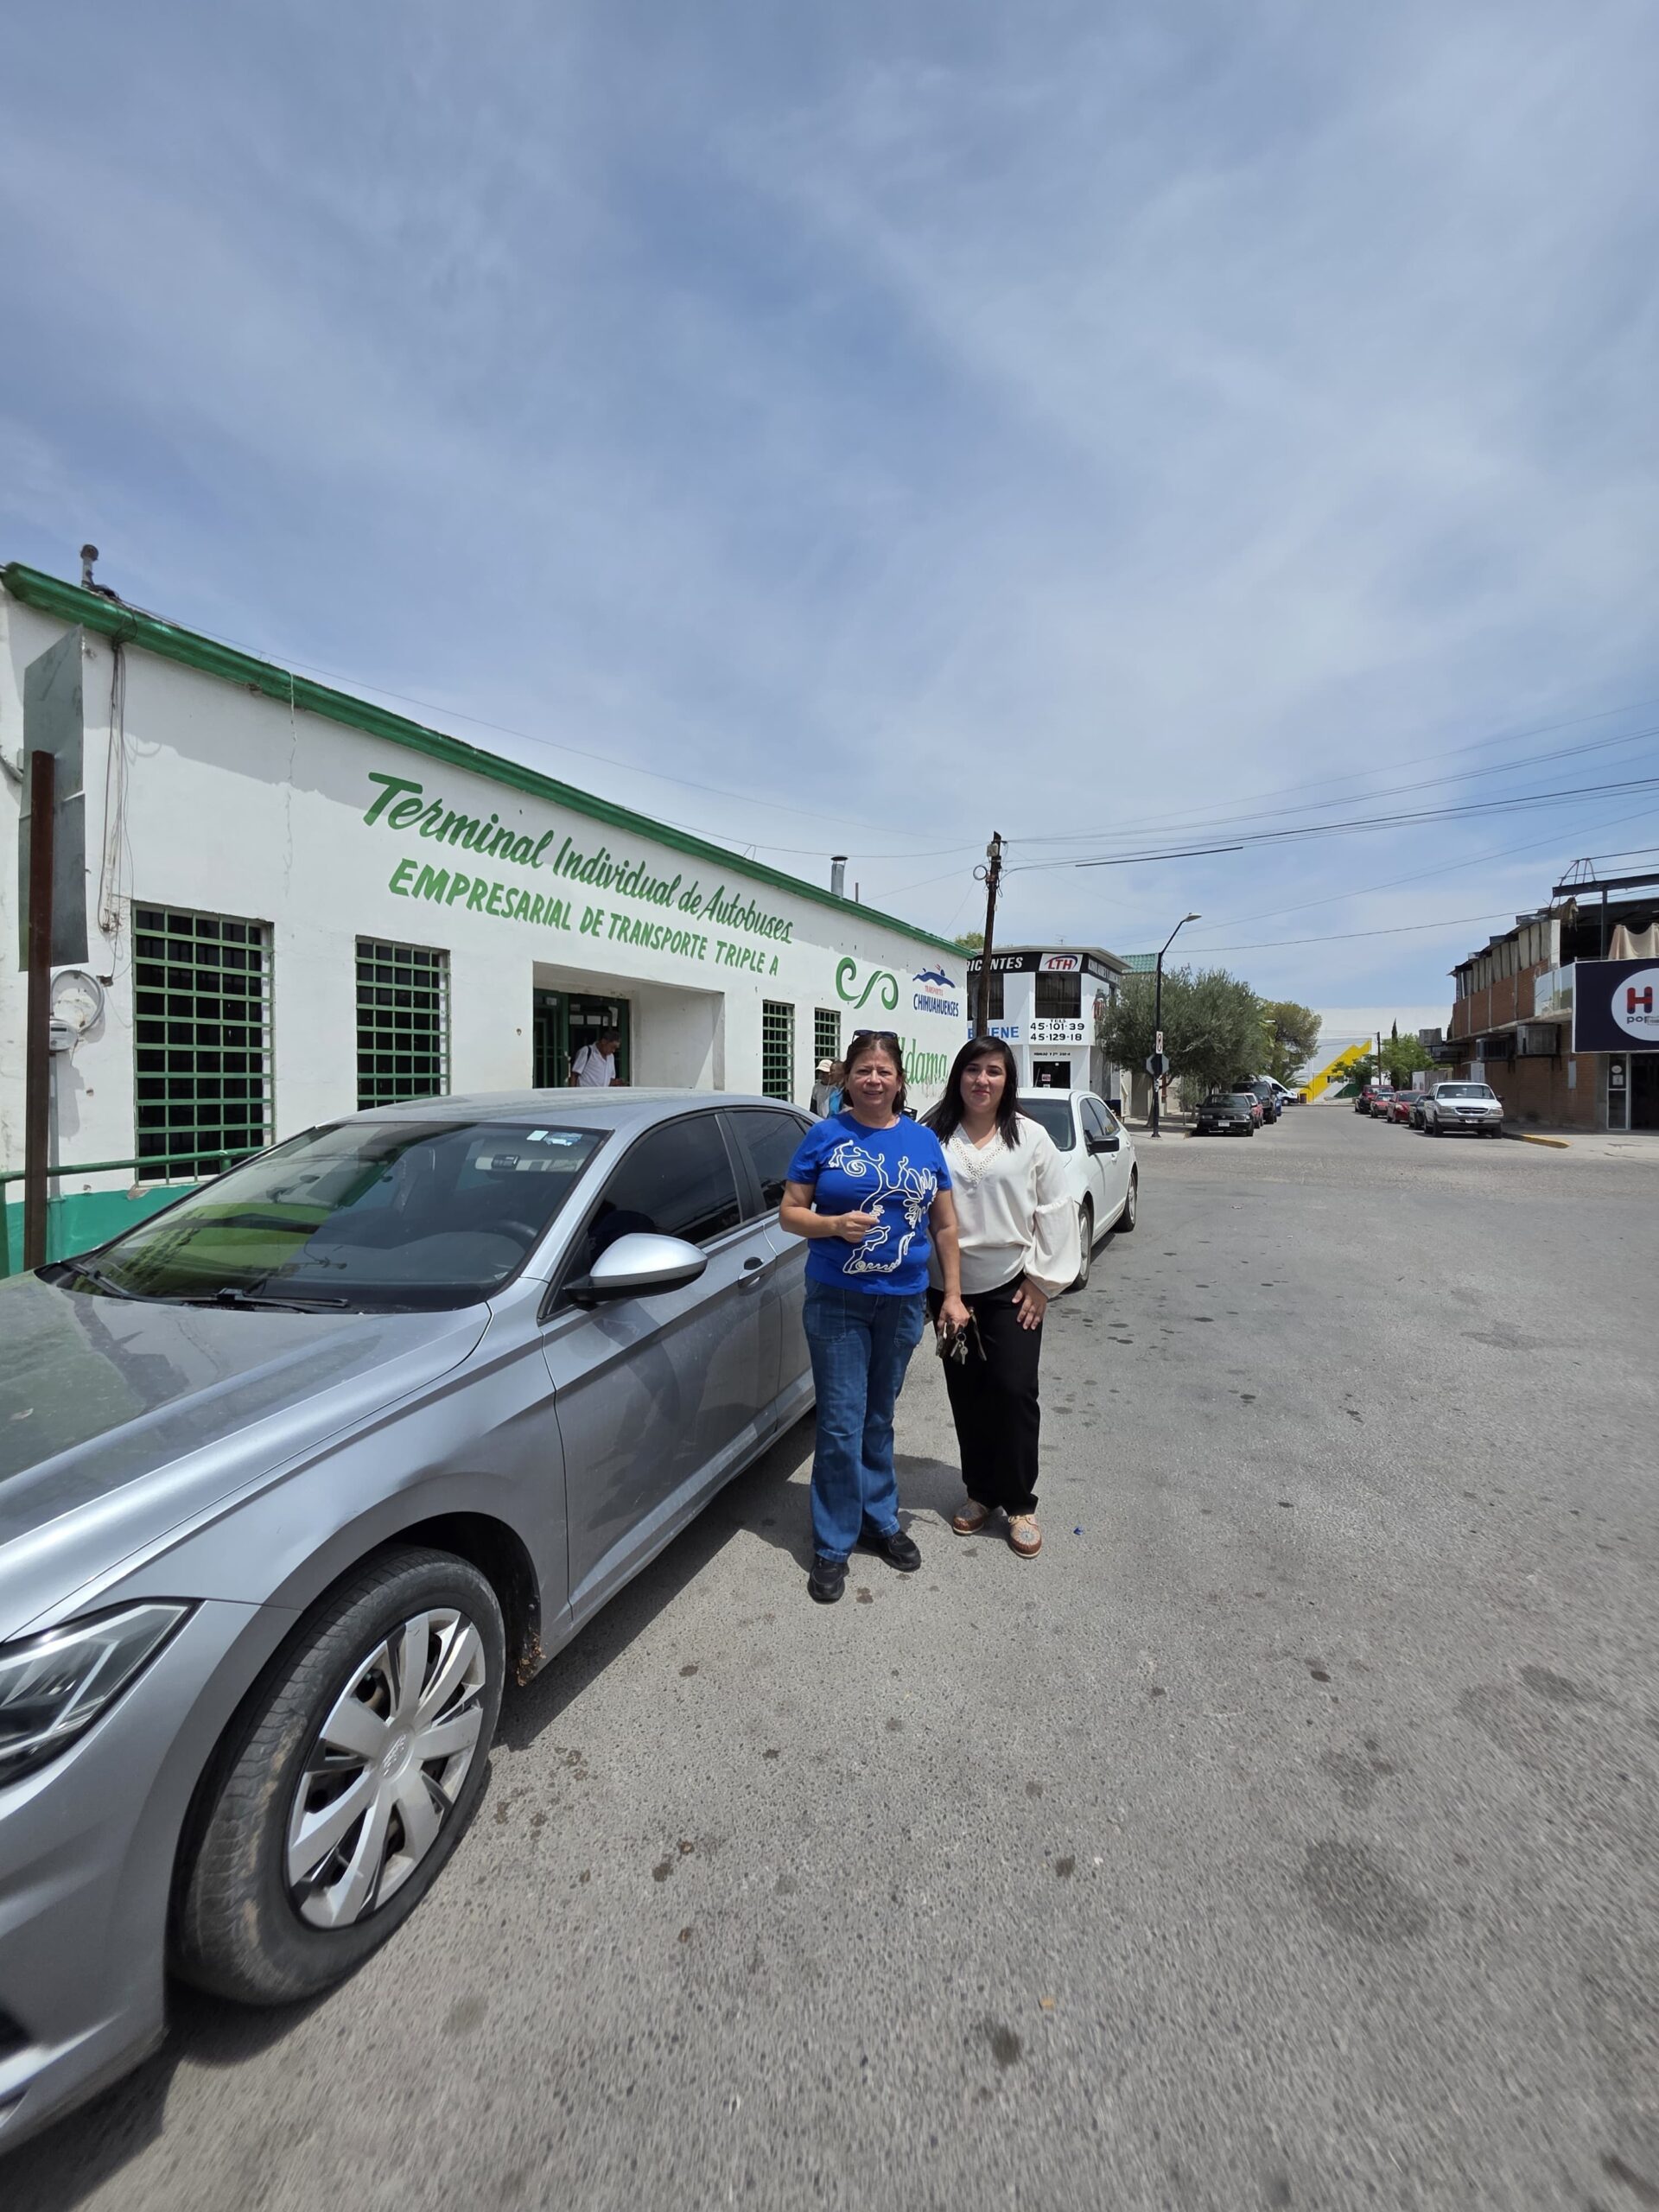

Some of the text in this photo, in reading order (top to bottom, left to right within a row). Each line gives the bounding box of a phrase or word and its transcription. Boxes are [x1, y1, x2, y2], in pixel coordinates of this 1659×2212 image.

[363, 772, 794, 944] Terminal Individual de Autobuses
[389, 857, 780, 977] EMPRESARIAL DE TRANSPORTE TRIPLE A
[1047, 958, 1073, 970] LTH
[912, 993, 959, 1017] CHIHUAHUENSES
[1626, 986, 1653, 1014] H
